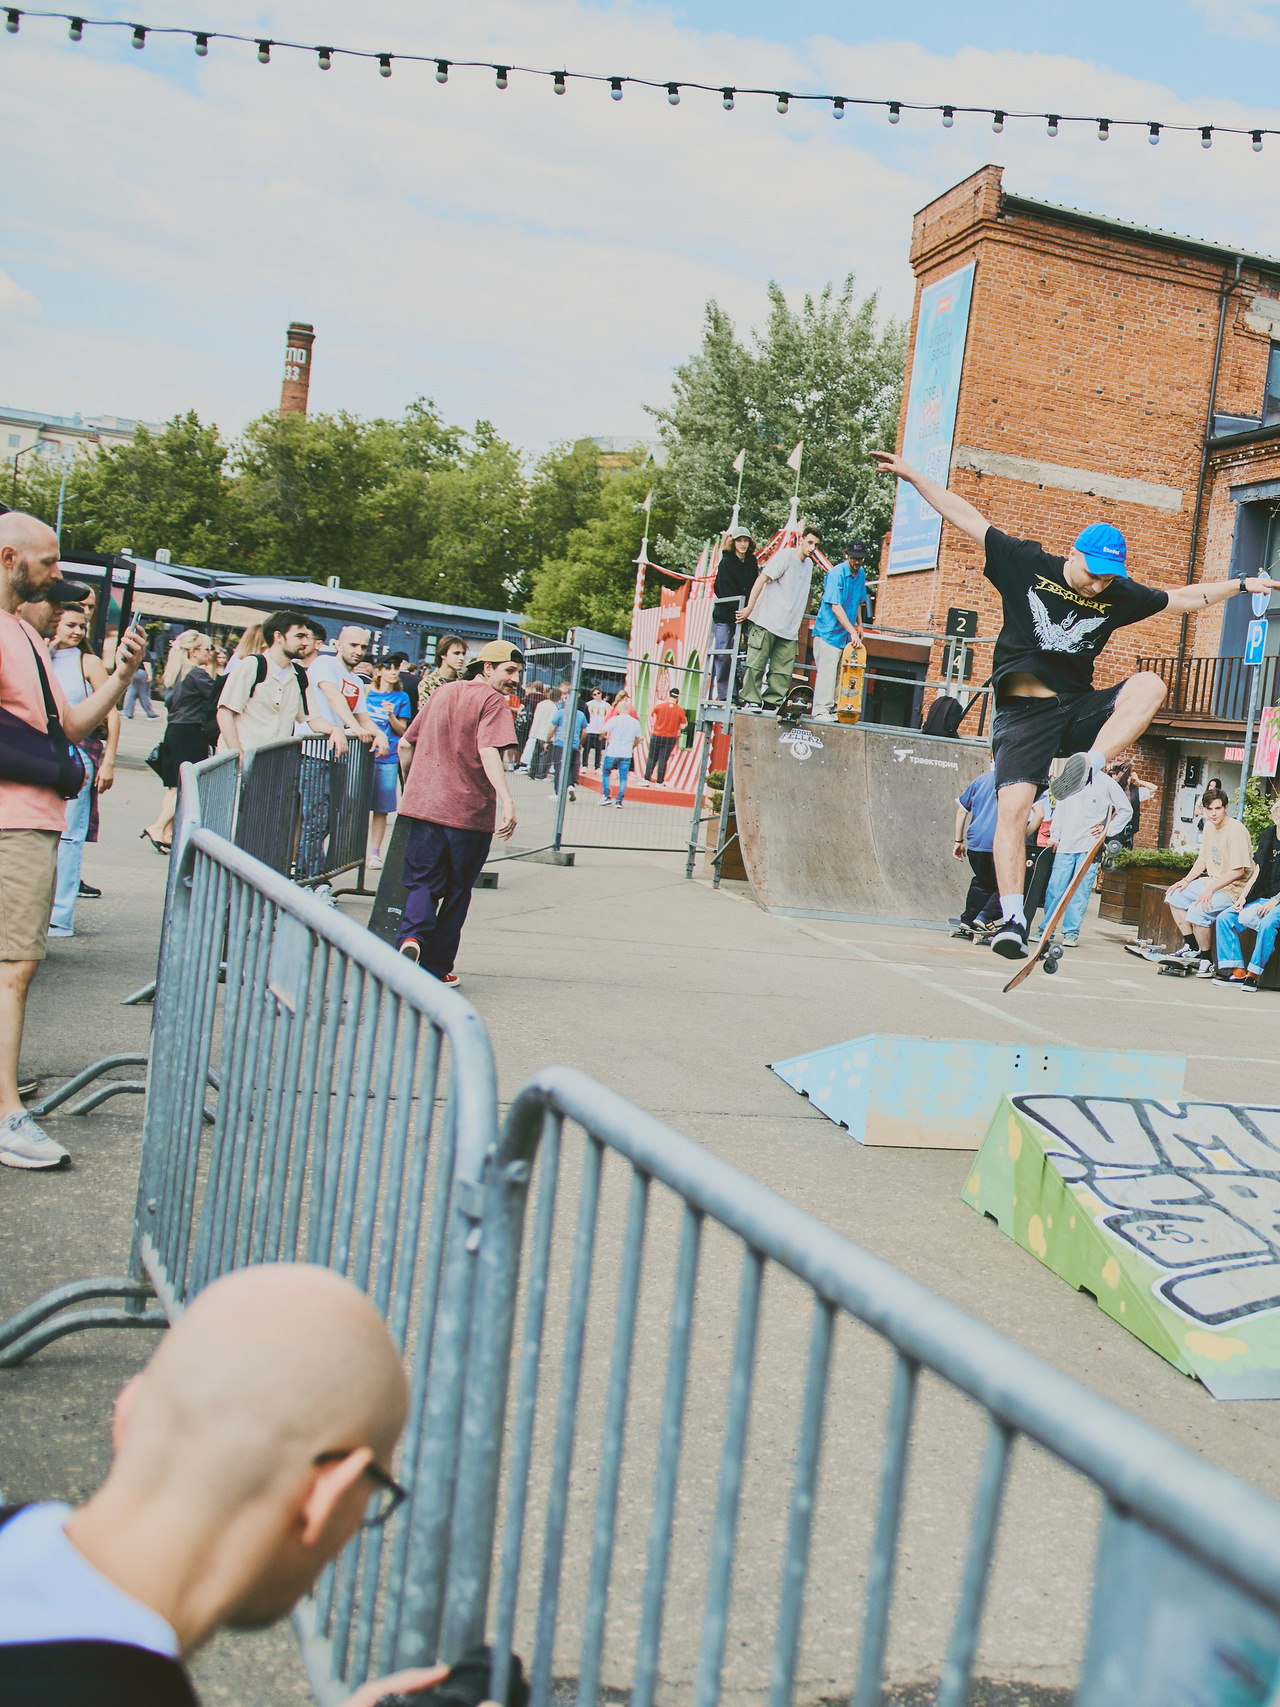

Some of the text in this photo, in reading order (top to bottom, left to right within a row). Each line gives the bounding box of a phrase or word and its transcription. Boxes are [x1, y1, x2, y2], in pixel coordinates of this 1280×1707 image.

[956, 617, 967, 632] 2
[1250, 625, 1263, 660] P
[909, 756, 959, 771] траектория
[1189, 765, 1195, 779] 5
